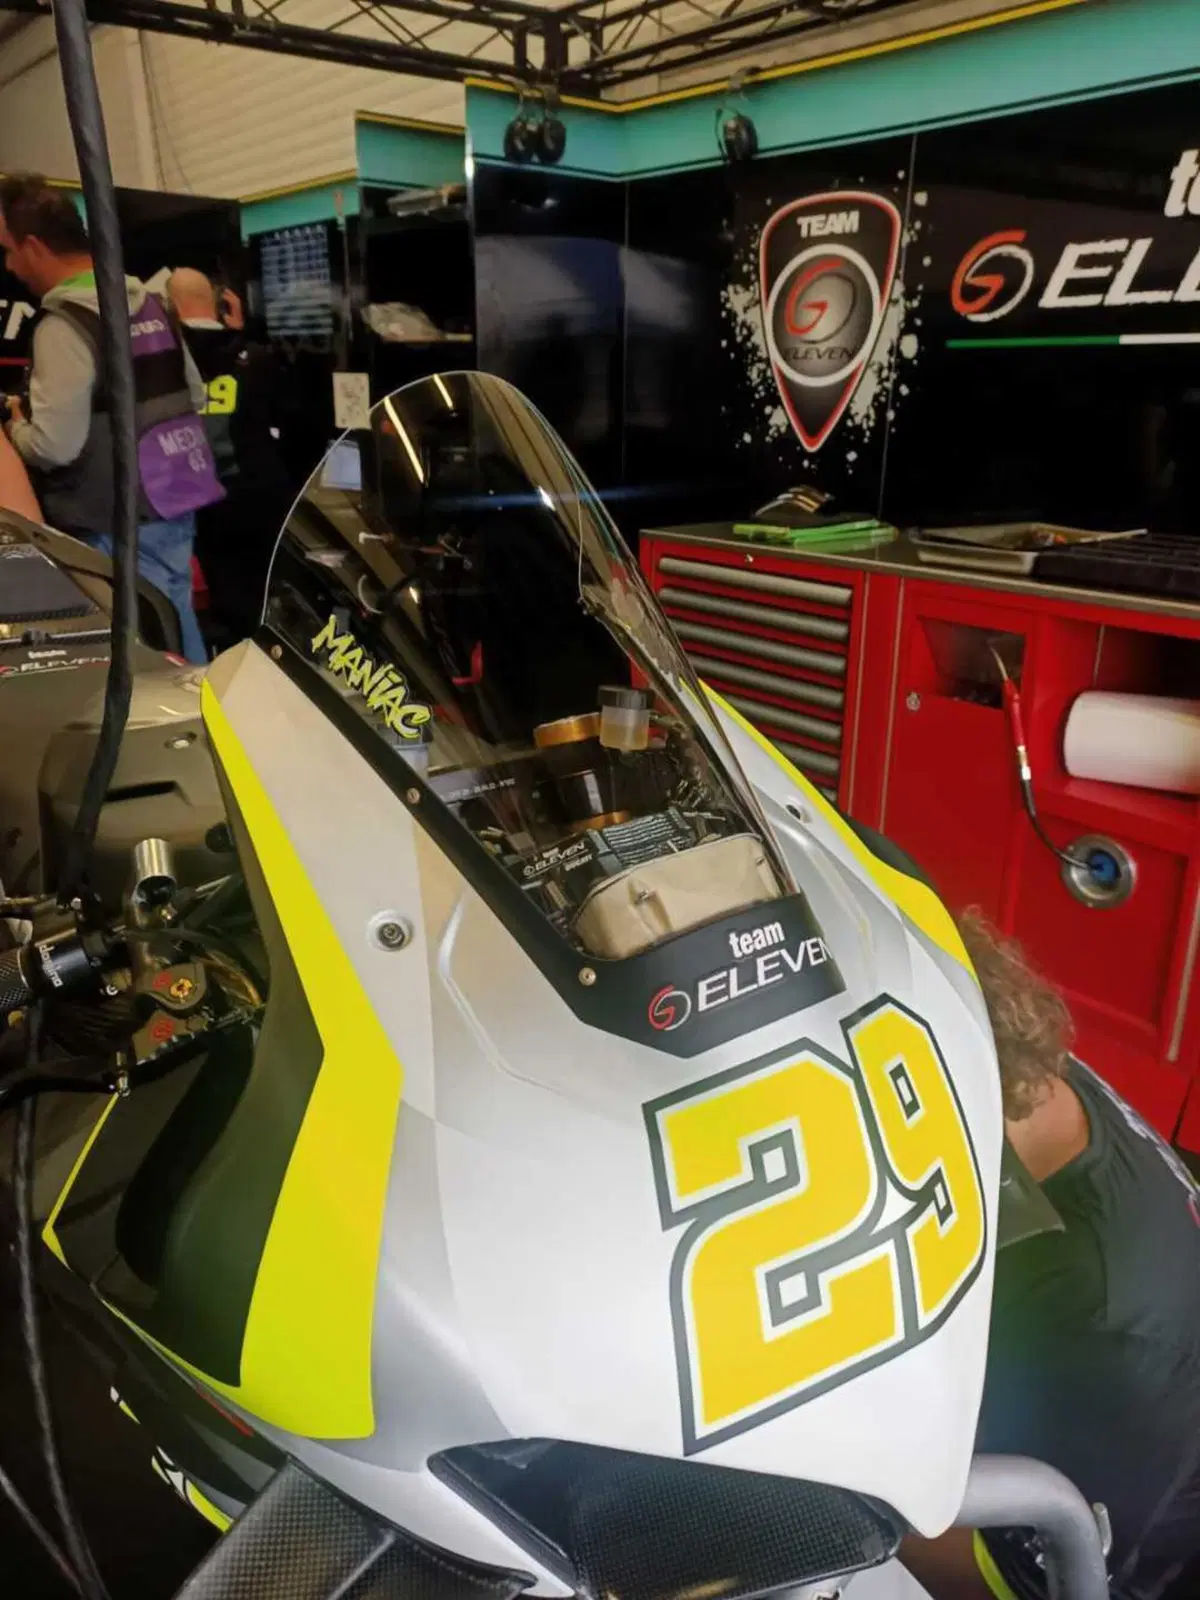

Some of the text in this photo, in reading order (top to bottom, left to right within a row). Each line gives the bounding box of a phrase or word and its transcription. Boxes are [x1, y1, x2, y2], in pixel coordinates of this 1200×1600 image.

[797, 210, 860, 238] TEAM
[197, 374, 238, 415] 9
[728, 921, 785, 958] team
[698, 936, 834, 1012] ELEVEN
[642, 993, 987, 1456] 29
